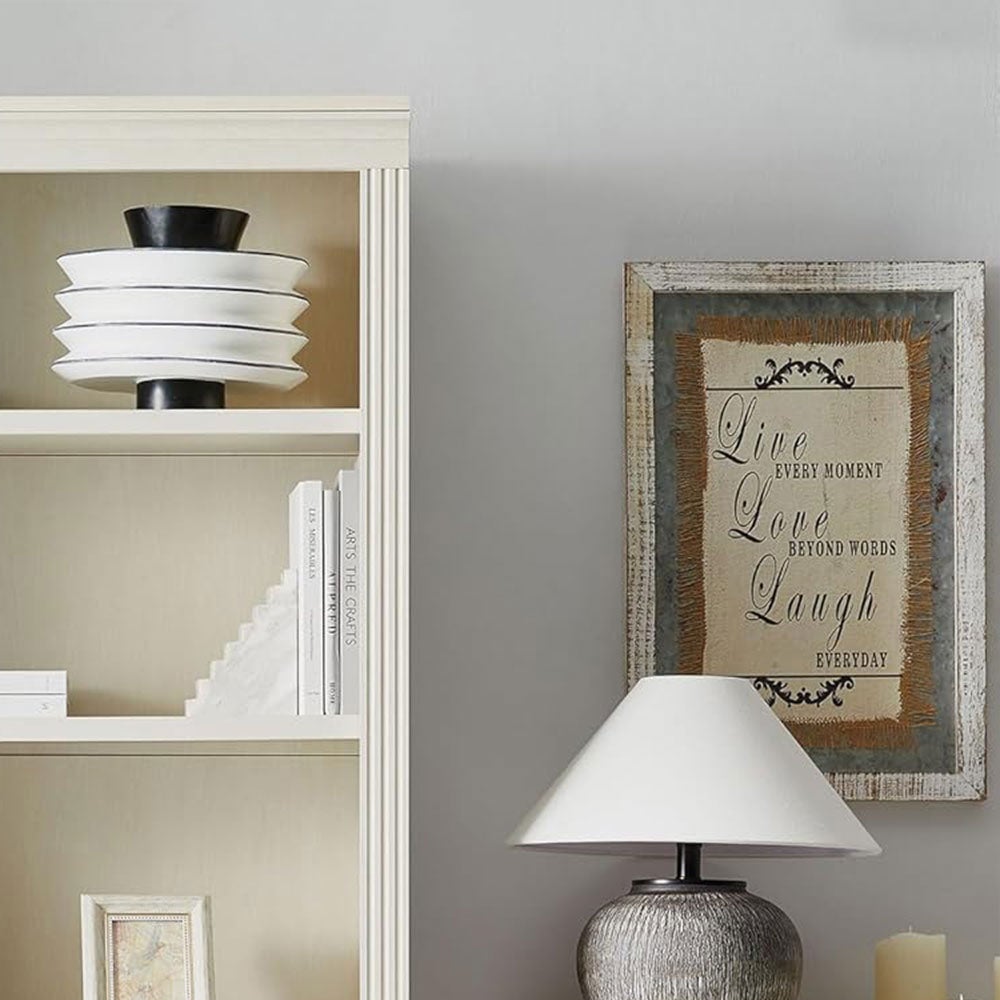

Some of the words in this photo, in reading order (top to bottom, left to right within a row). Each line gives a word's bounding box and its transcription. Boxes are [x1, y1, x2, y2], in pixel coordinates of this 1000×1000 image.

[712, 391, 808, 465] Live
[775, 463, 819, 480] EVERY
[824, 462, 883, 479] MOMENT
[728, 471, 829, 544] Love
[345, 527, 357, 560] ARTS
[788, 540, 844, 557] BEYOND
[849, 540, 897, 557] WORDS
[344, 566, 356, 592] THE
[744, 554, 878, 652] Laugh
[344, 598, 357, 647] CRAFTS
[816, 651, 888, 669] EVERYDAY
